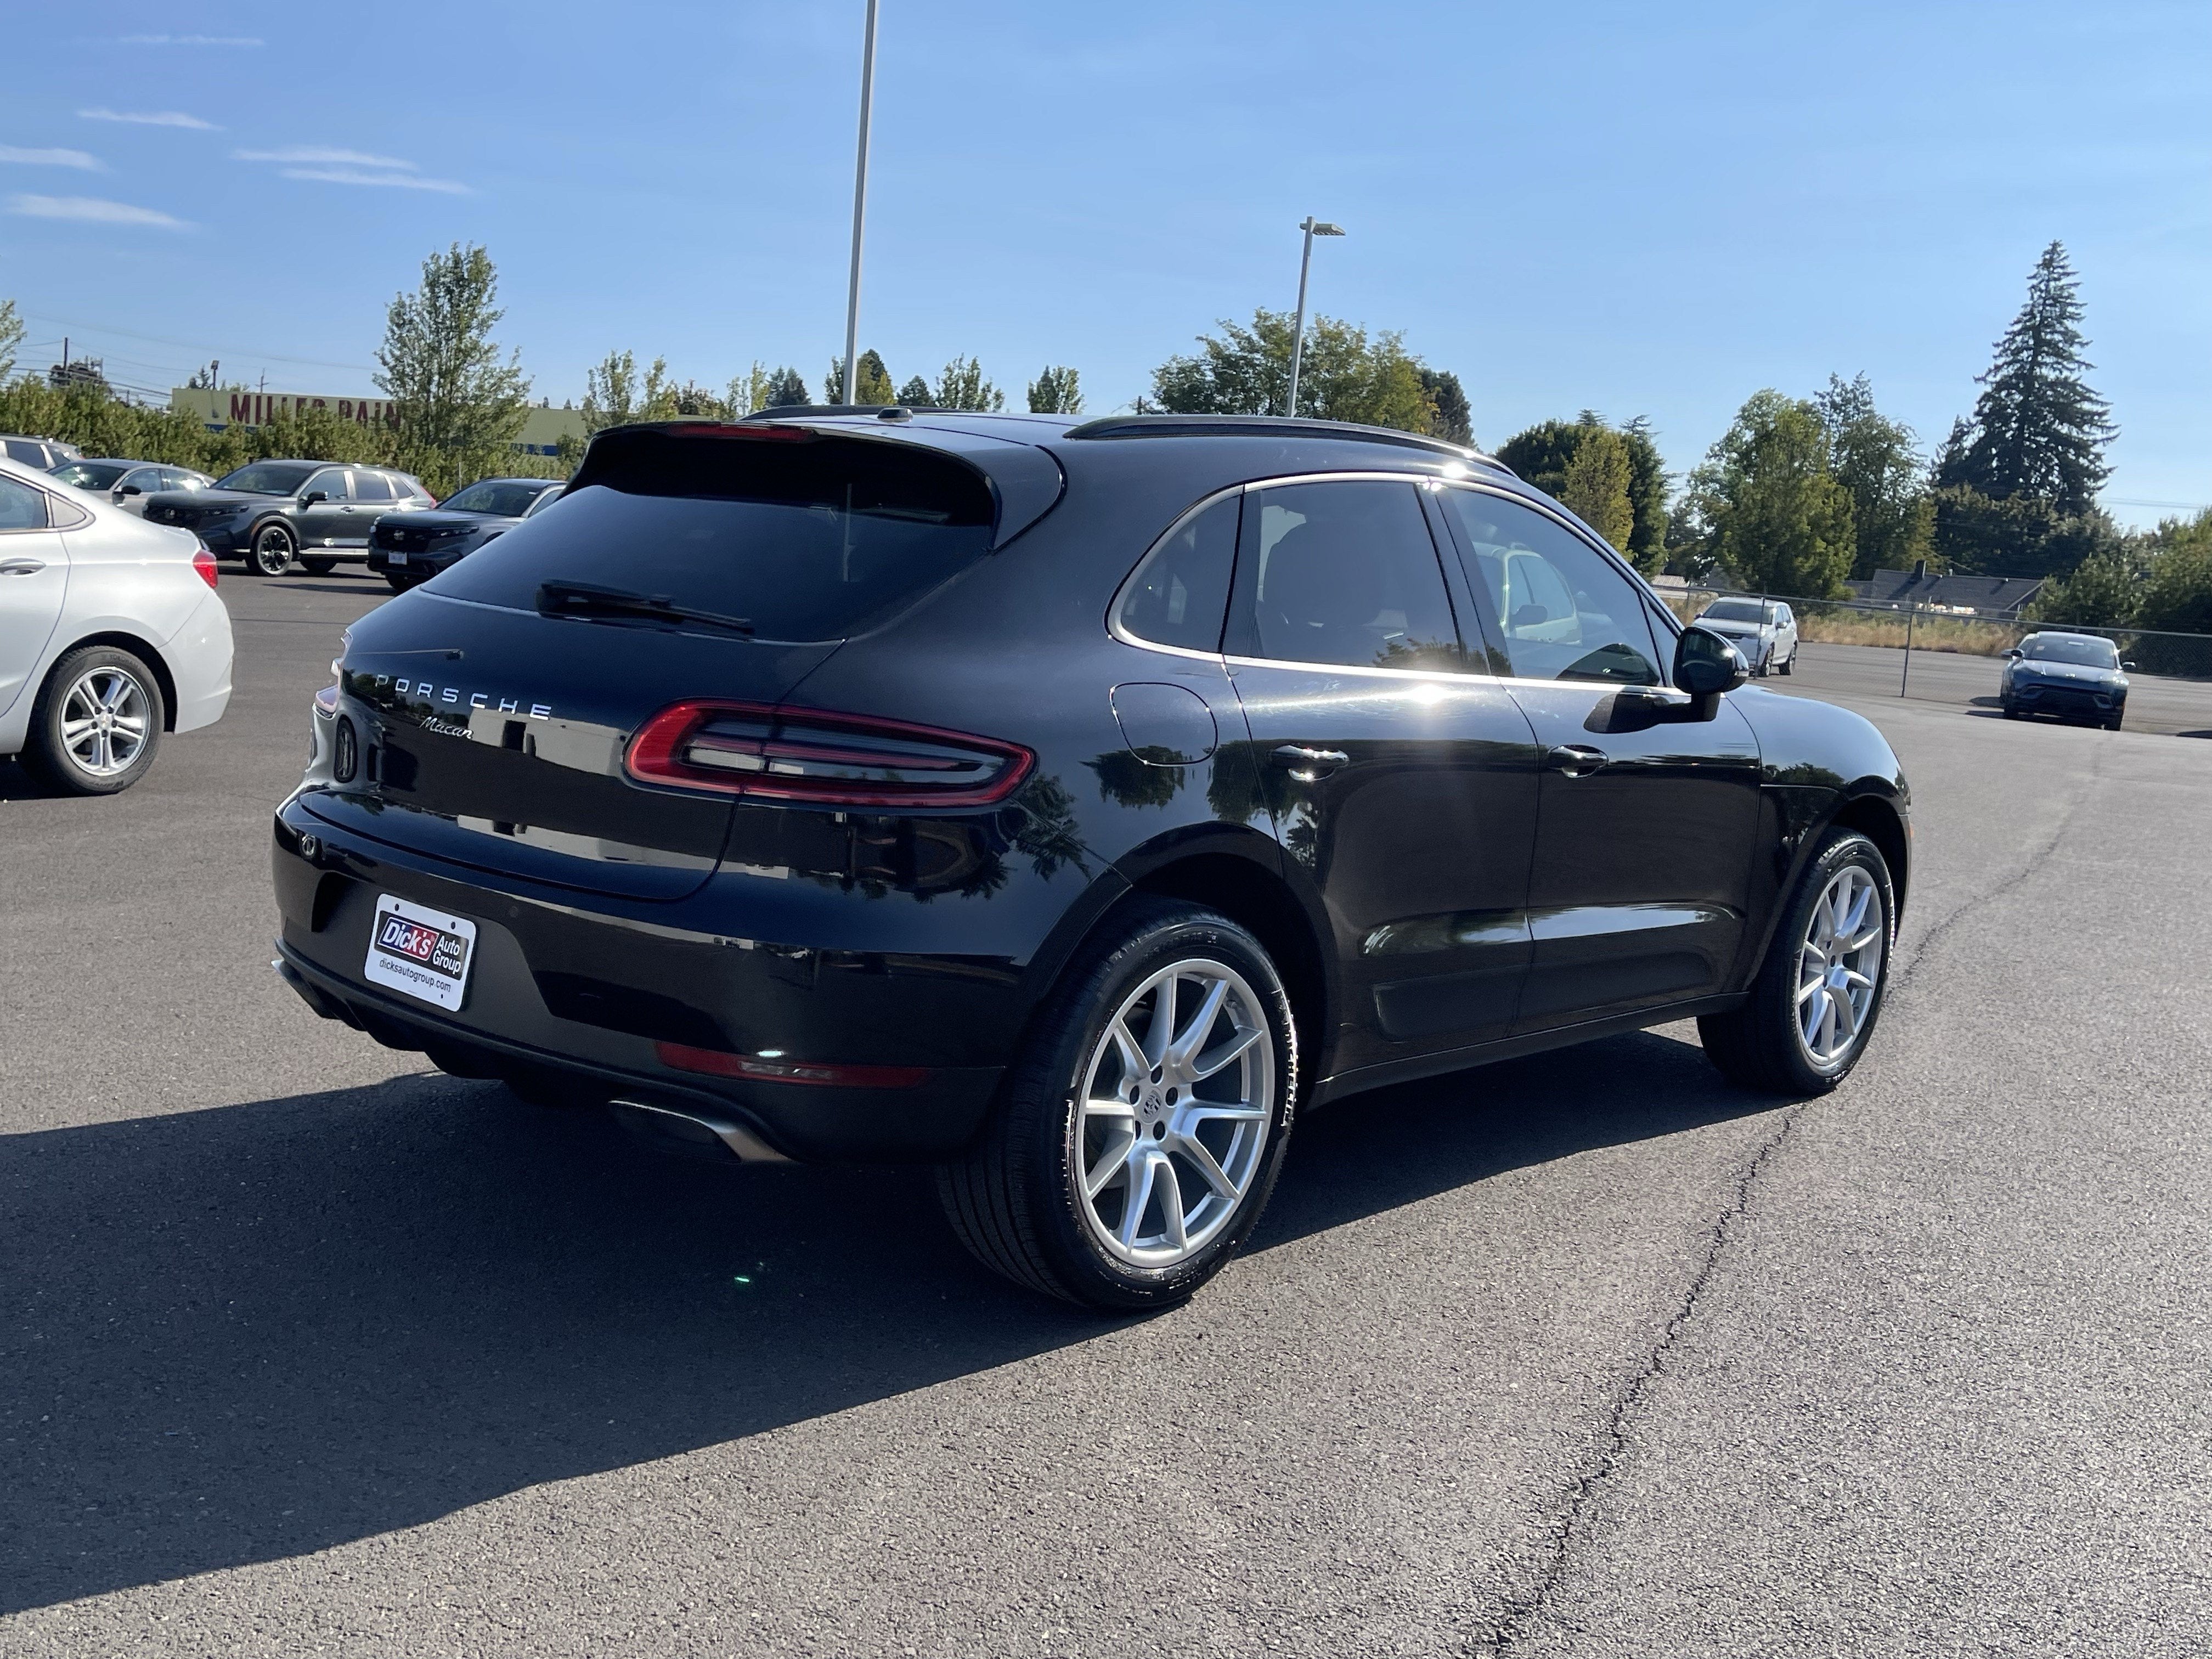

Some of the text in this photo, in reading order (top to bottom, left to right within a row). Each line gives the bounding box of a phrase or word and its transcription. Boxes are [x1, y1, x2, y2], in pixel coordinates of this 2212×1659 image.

[375, 674, 551, 721] PORSCHE
[419, 716, 473, 740] Macan
[382, 922, 432, 956] Dick's
[436, 935, 460, 956] Auto
[379, 958, 452, 992] dicksautogroup.com
[432, 950, 461, 974] Group
